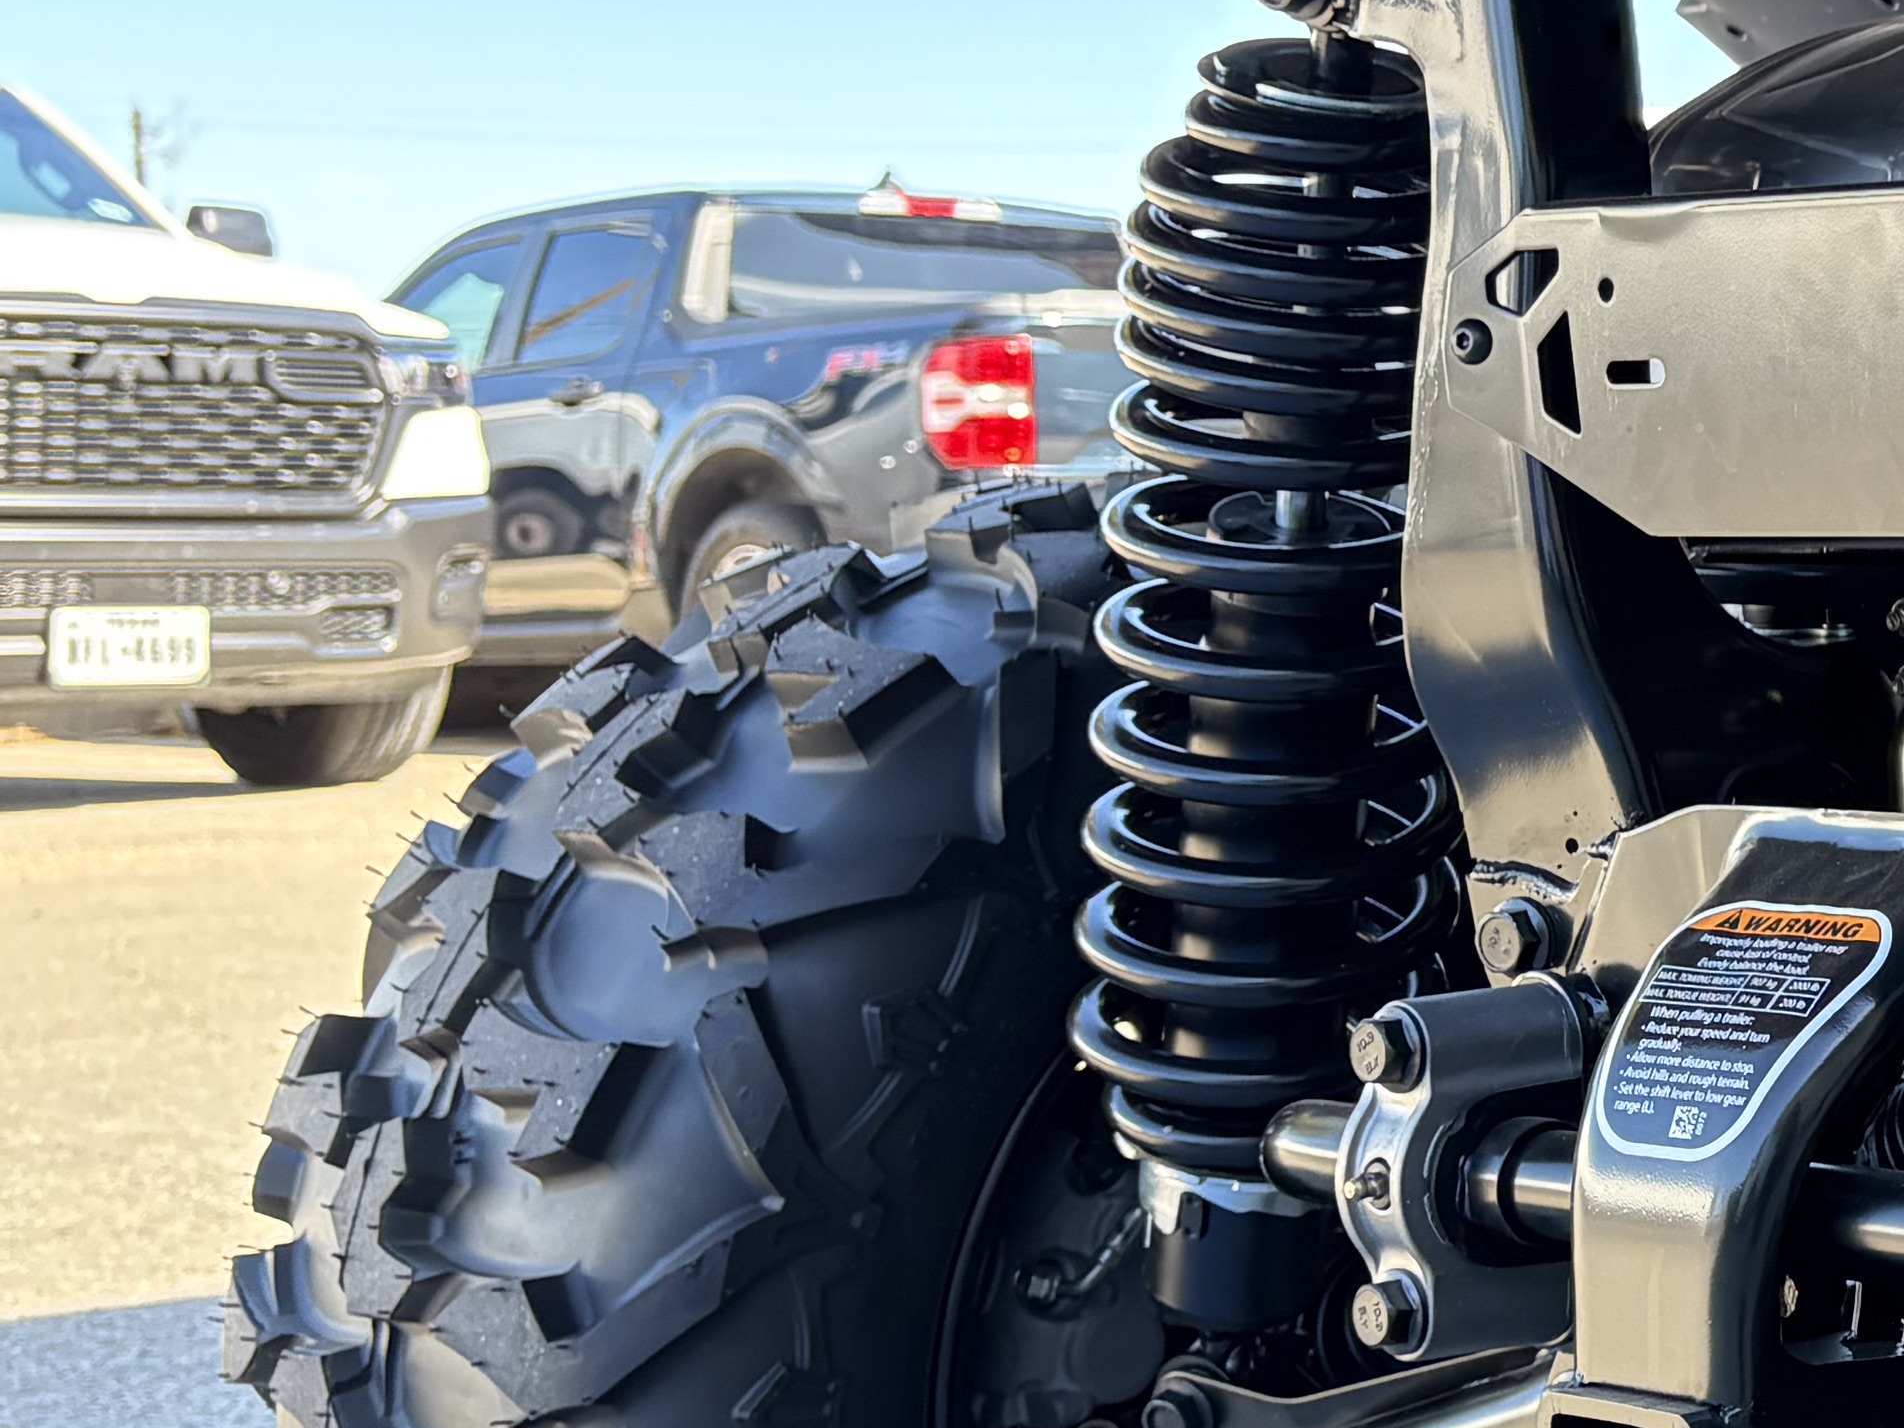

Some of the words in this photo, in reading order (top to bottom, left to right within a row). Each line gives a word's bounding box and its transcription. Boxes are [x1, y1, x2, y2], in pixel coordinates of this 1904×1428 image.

[1743, 916, 1863, 938] WARNING
[1700, 933, 1751, 949] Improperly
[1753, 938, 1786, 951] loading
[1788, 941, 1796, 949] a
[1797, 941, 1824, 953] trailer
[1824, 944, 1848, 955] may
[1716, 949, 1743, 958] cause
[1743, 950, 1760, 960] loss
[1761, 951, 1773, 961] of
[1697, 956, 1731, 970] Evenly
[1730, 960, 1764, 971] balance
[1765, 961, 1784, 973] the
[1766, 978, 1779, 990] kg
[1811, 982, 1820, 992] lb
[1750, 995, 1762, 1006] kg
[1797, 1000, 1806, 1010] lb
[1650, 1006, 1678, 1019] When
[1678, 1009, 1714, 1022] pulling
[1714, 1012, 1722, 1022] a
[1645, 1021, 1679, 1035] Reduce
[1678, 1026, 1700, 1038] your
[1700, 1028, 1731, 1040] speed
[1730, 1029, 1749, 1041] and
[1749, 1031, 1770, 1043] turn
[1356, 1031, 1375, 1053] 10.9
[1630, 1051, 1657, 1063] Allow
[1657, 1055, 1682, 1067] more
[1682, 1056, 1721, 1070] distance
[1721, 1059, 1732, 1071] to
[1731, 1061, 1755, 1075] stop.
[1624, 1066, 1652, 1080] Avoid
[1651, 1068, 1670, 1082] hills
[1669, 1071, 1689, 1083] and
[1689, 1074, 1717, 1088] rough
[1717, 1075, 1750, 1090] terrain.
[1617, 1081, 1634, 1094] Set
[1634, 1083, 1651, 1096] the
[1651, 1084, 1670, 1098] shift
[1670, 1086, 1694, 1100] lever
[1694, 1089, 1705, 1101] to
[1705, 1090, 1722, 1103] low
[1722, 1094, 1747, 1107] gear
[1613, 1100, 1641, 1114] range
